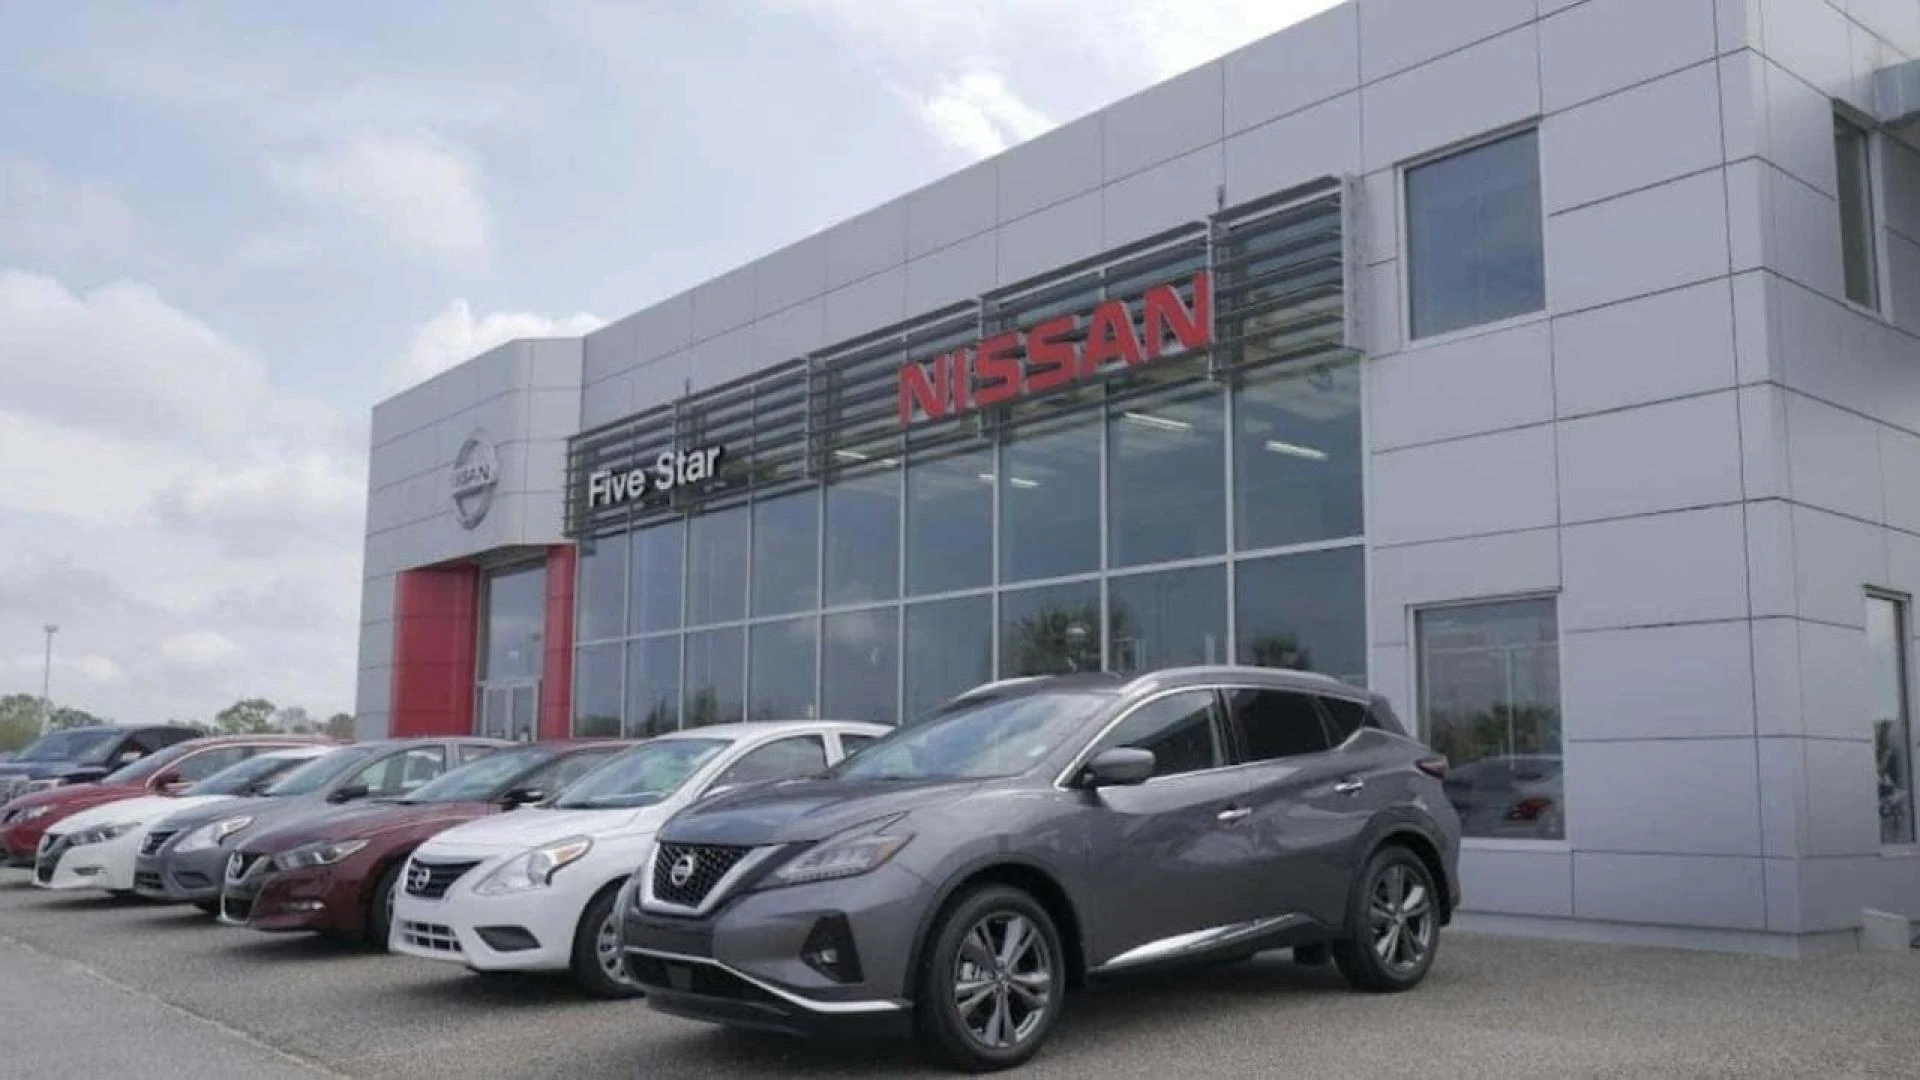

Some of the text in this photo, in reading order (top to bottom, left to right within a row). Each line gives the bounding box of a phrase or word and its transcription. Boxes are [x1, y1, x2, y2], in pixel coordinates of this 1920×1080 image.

[897, 271, 1212, 427] NISSAN
[588, 446, 721, 507] Five Star
